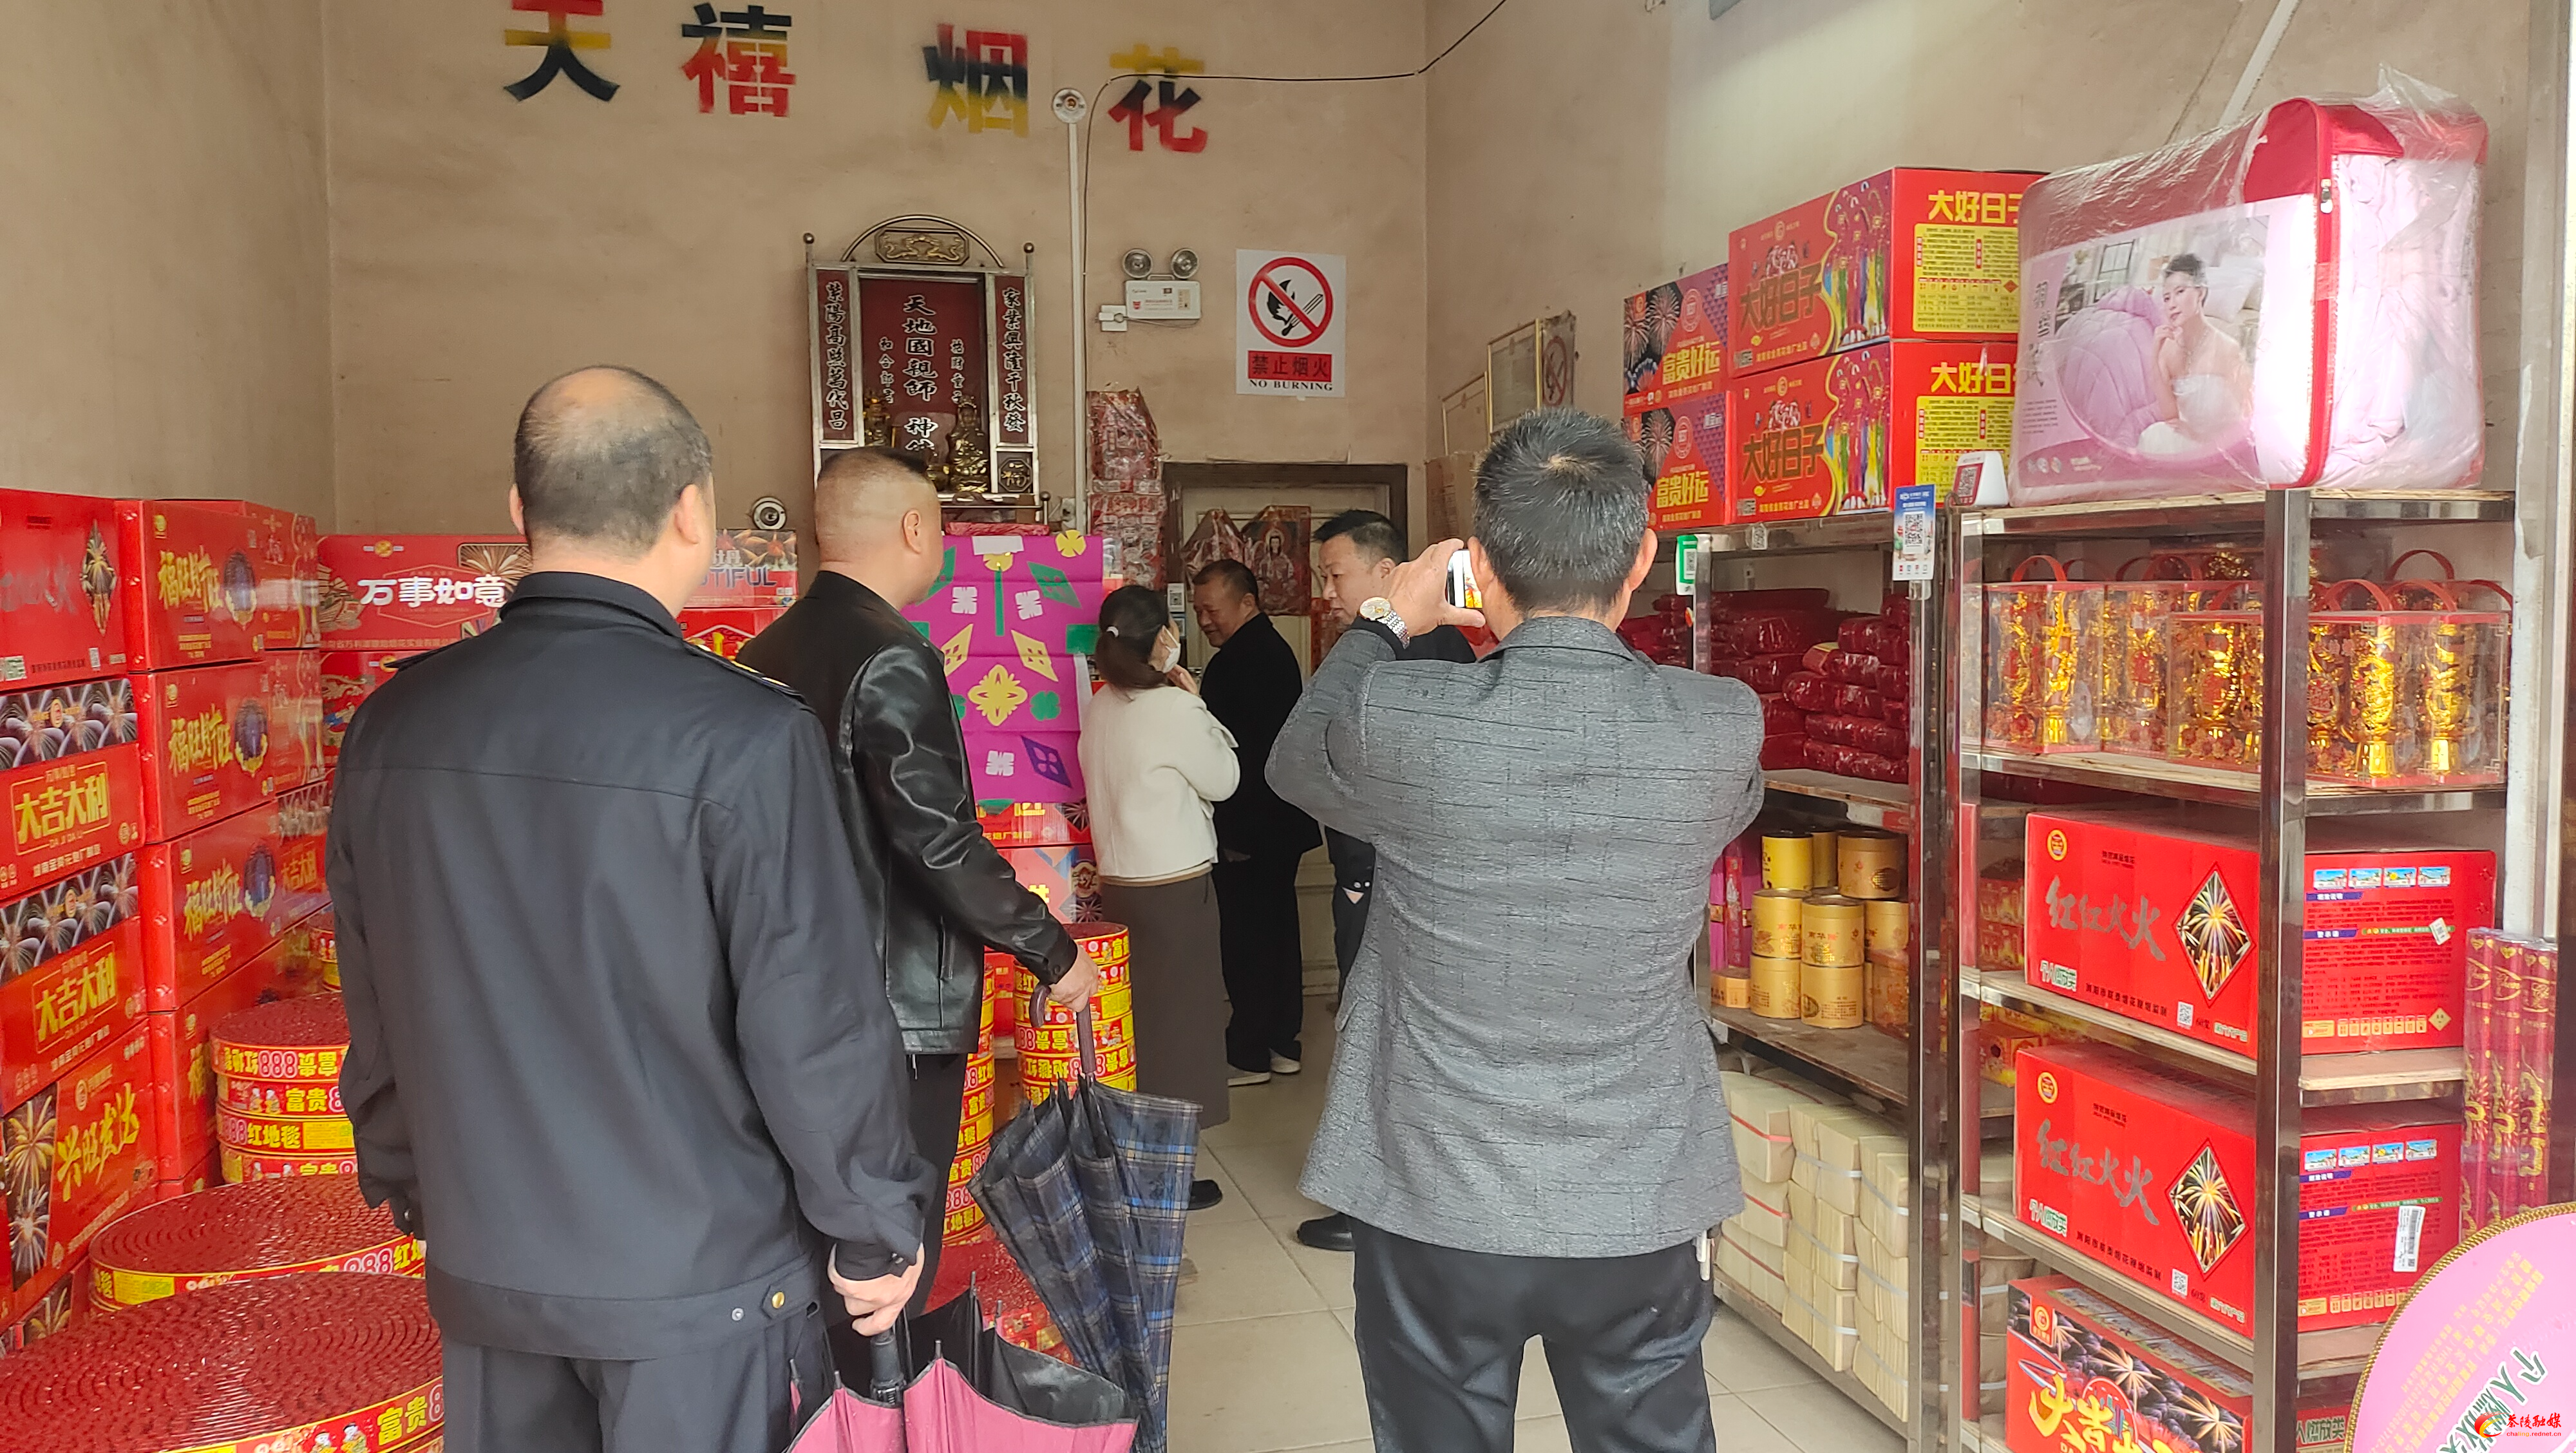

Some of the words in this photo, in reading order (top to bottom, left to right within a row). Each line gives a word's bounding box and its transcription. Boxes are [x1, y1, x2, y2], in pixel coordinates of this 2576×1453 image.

[504, 0, 1208, 153] 天禧烟花
[1740, 263, 1822, 331] 大好日子
[904, 294, 936, 401] 天地國親師
[1252, 354, 1329, 377] 禁止烟火
[1662, 341, 1721, 385] 富贵好运
[1931, 361, 2016, 395] 大好日
[1249, 379, 1267, 389] NO
[1273, 380, 1333, 392] BURNING
[1743, 423, 1824, 484] 大好日子
[1656, 471, 1709, 508] 富贵好运
[359, 573, 507, 608] 万事如意
[15, 772, 109, 845] 大吉大利
[2045, 875, 2166, 962] 红红火火
[36, 952, 117, 1042] 大吉大利
[2036, 1117, 2160, 1226] 红红火火
